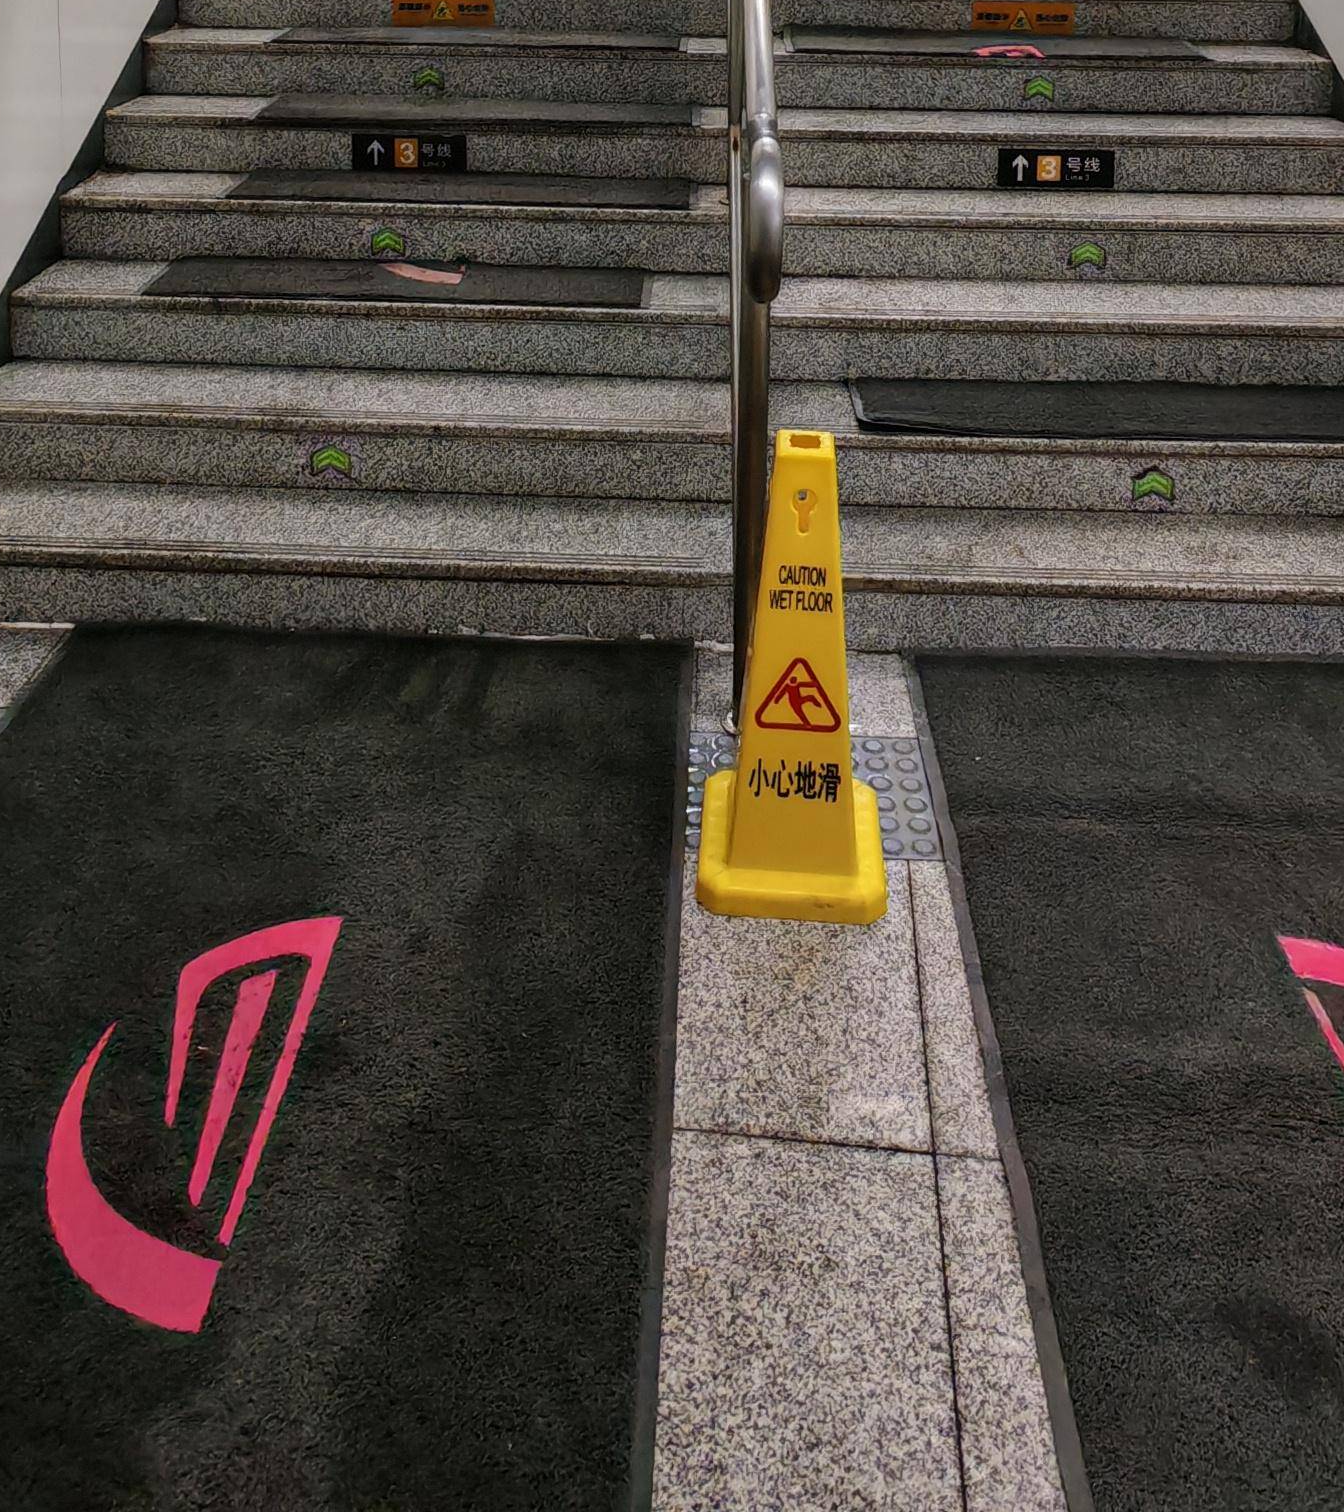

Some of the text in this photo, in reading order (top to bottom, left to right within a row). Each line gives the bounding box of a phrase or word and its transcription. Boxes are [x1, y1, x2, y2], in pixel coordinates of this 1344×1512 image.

[399, 142, 452, 164] 3 号线
[1041, 156, 1101, 179] 3 号线
[778, 565, 827, 587] CAUTION
[769, 589, 833, 613] WET FLOOR
[748, 758, 842, 803] 小心地滑
